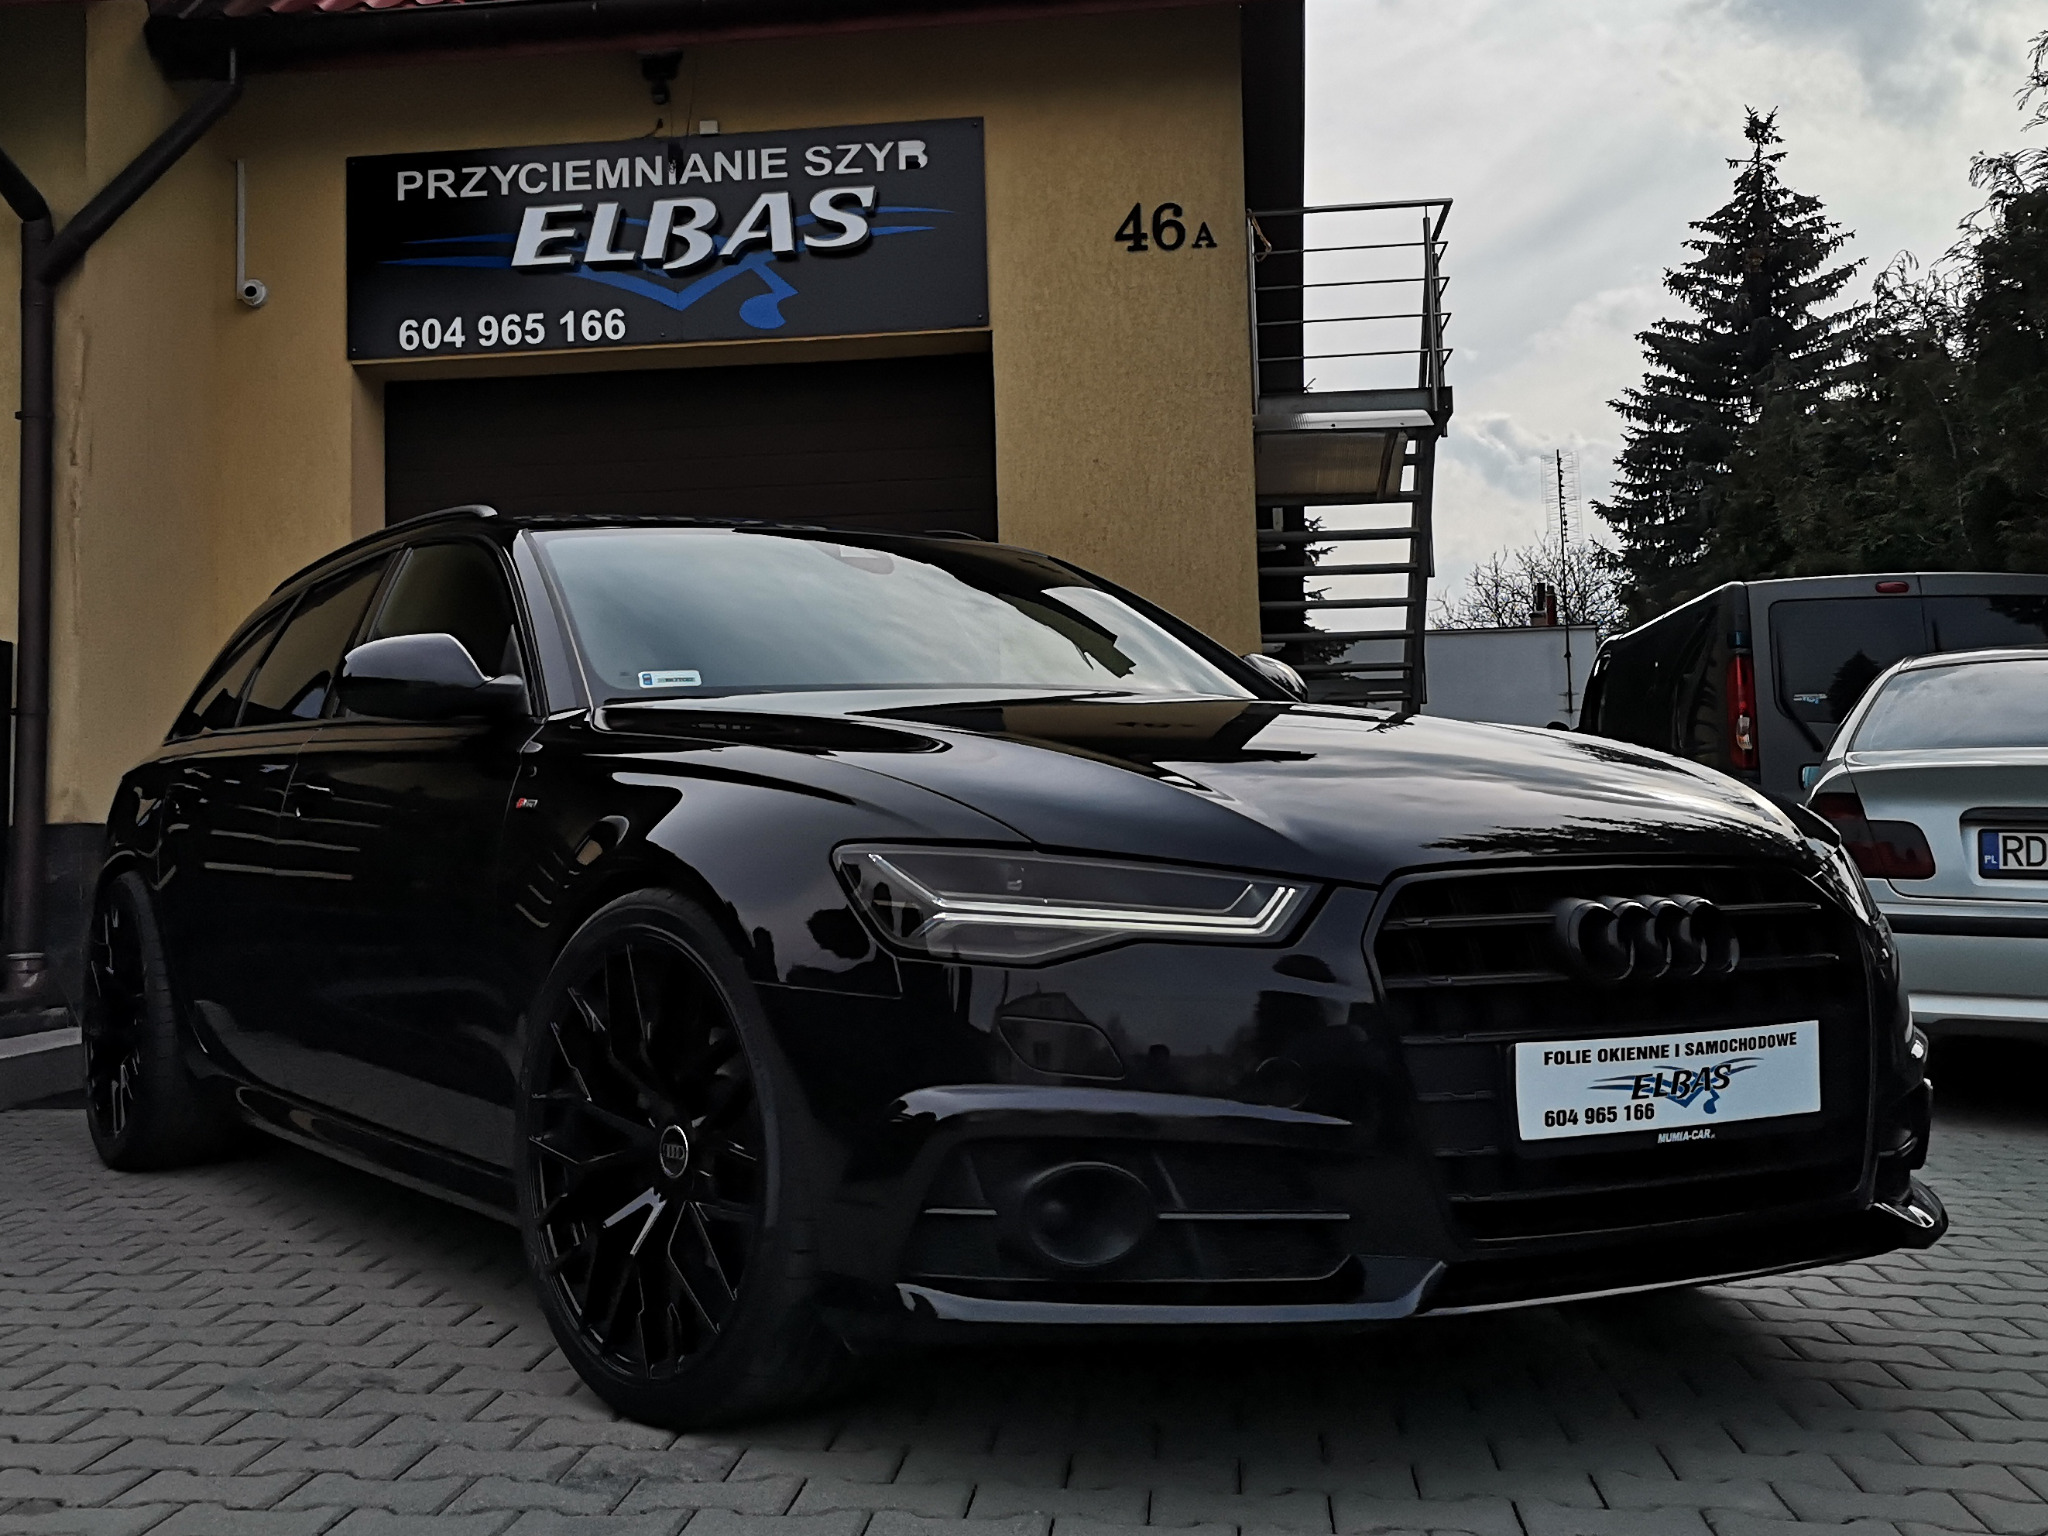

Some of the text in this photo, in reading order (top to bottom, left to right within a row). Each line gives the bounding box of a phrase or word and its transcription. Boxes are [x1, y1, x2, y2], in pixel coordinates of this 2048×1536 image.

[510, 184, 877, 271] ELBAS
[399, 308, 626, 351] 604 965 166
[1984, 855, 1997, 864] PL
[2001, 835, 2047, 867] RD
[1543, 1031, 1797, 1066] FOLIE OKIENNE I SAMOCHODOWE
[1631, 1063, 1732, 1100] ELBAS
[1544, 1103, 1655, 1128] 604 965 166
